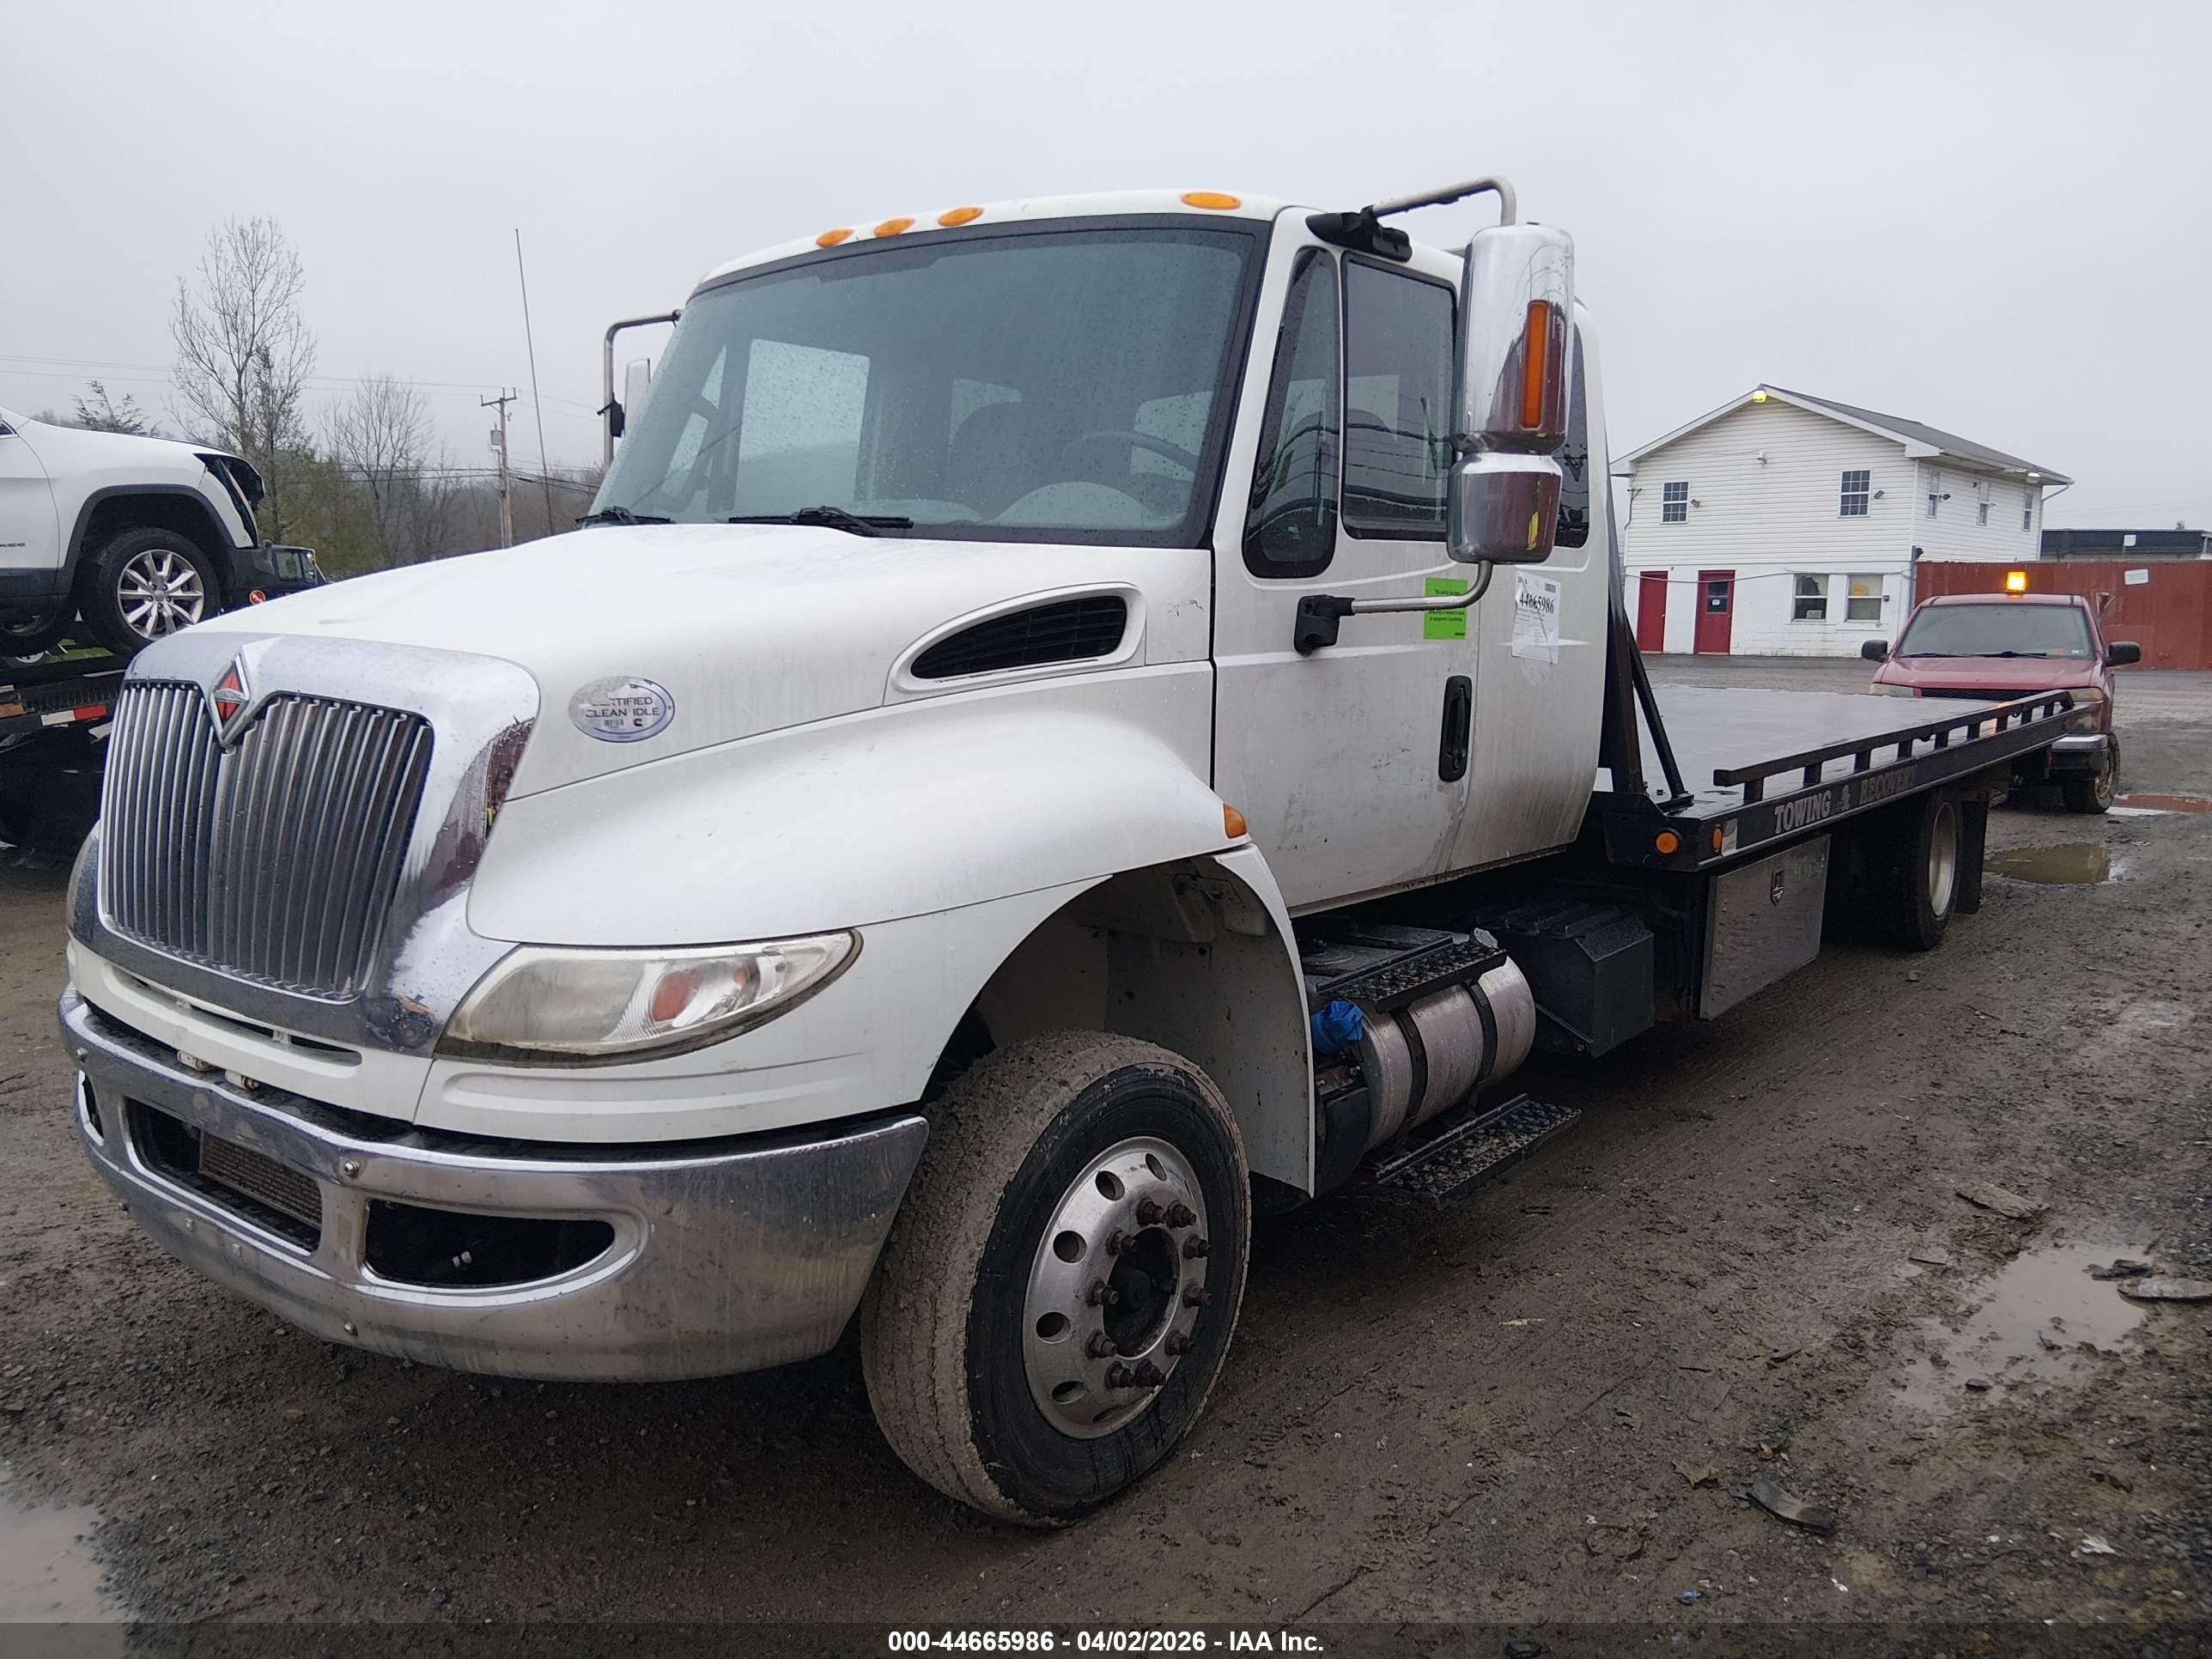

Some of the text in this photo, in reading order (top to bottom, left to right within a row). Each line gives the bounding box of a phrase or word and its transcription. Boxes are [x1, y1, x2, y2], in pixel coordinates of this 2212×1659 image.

[1519, 591, 1555, 615] 44665986
[591, 696, 653, 707] TIFIED
[633, 707, 660, 716] IDLE
[1774, 790, 1832, 834] TOWING
[1858, 765, 1917, 805] RECOVERY
